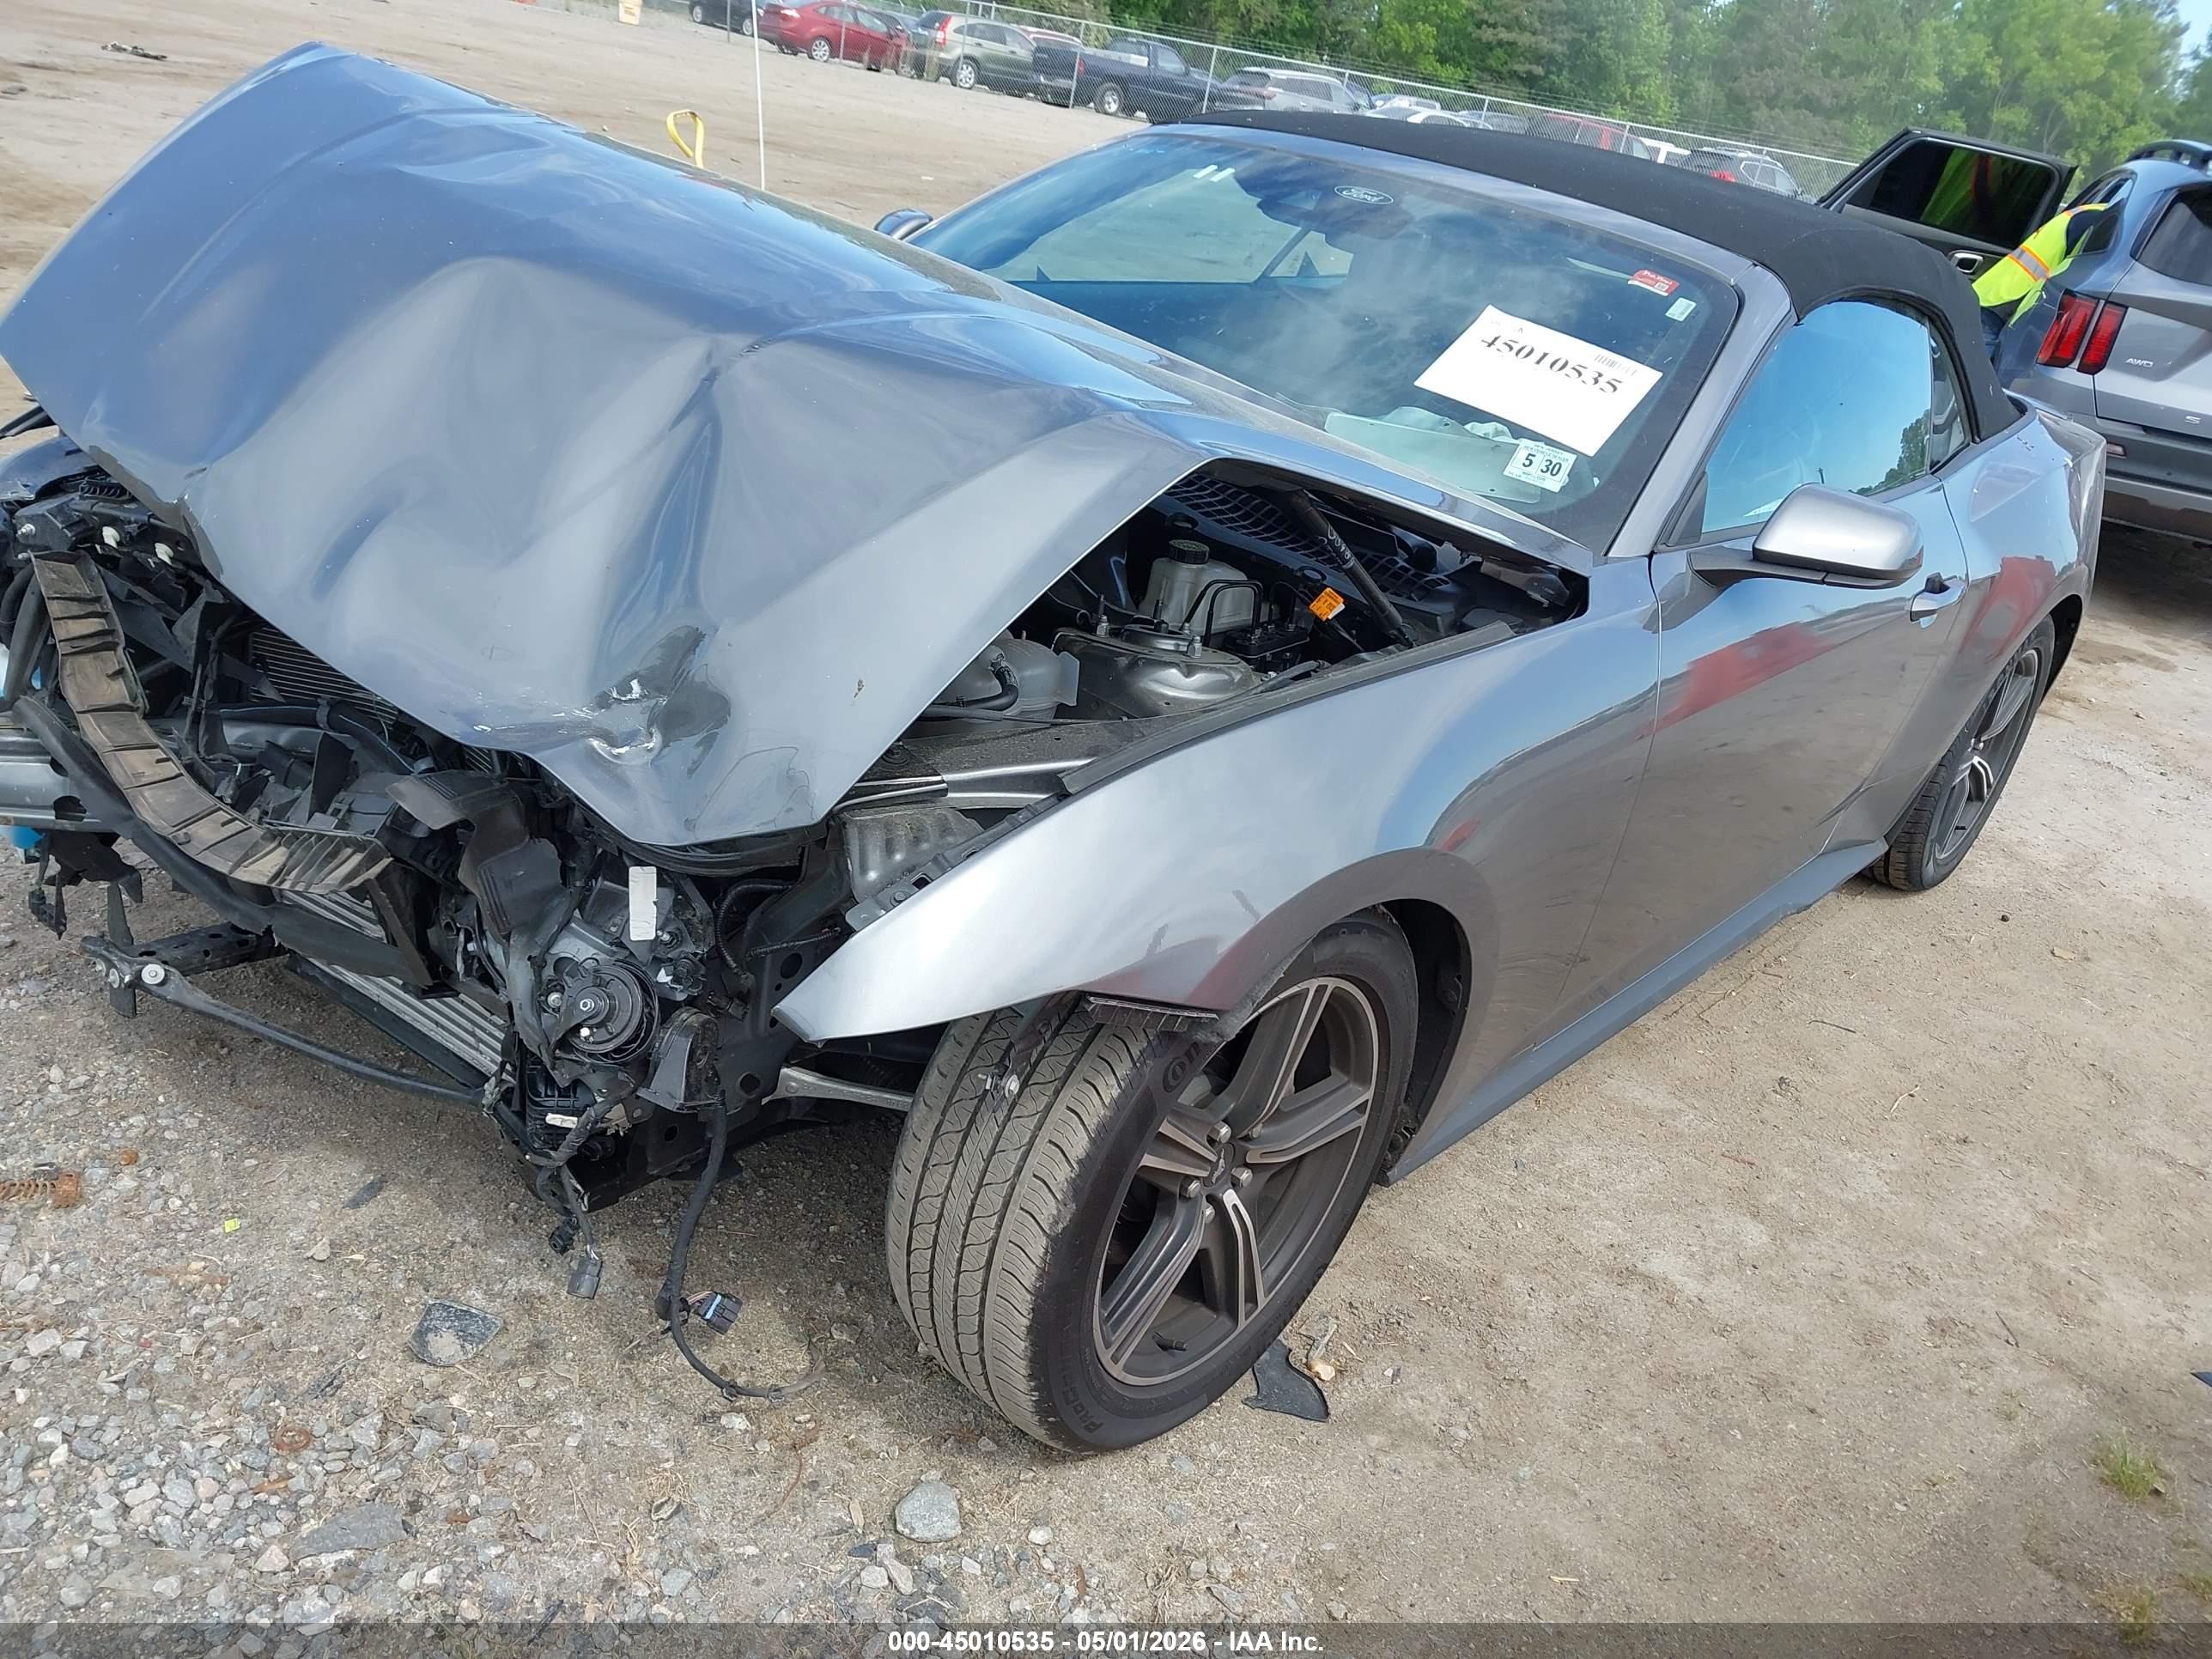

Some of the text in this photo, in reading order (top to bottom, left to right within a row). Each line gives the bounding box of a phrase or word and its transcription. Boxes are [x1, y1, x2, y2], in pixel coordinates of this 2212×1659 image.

[1340, 188, 1385, 203] Ford
[1481, 336, 1623, 393] 45010535
[2125, 358, 2154, 368] AWD
[1522, 453, 1535, 467] 5
[1540, 459, 1562, 477] 30
